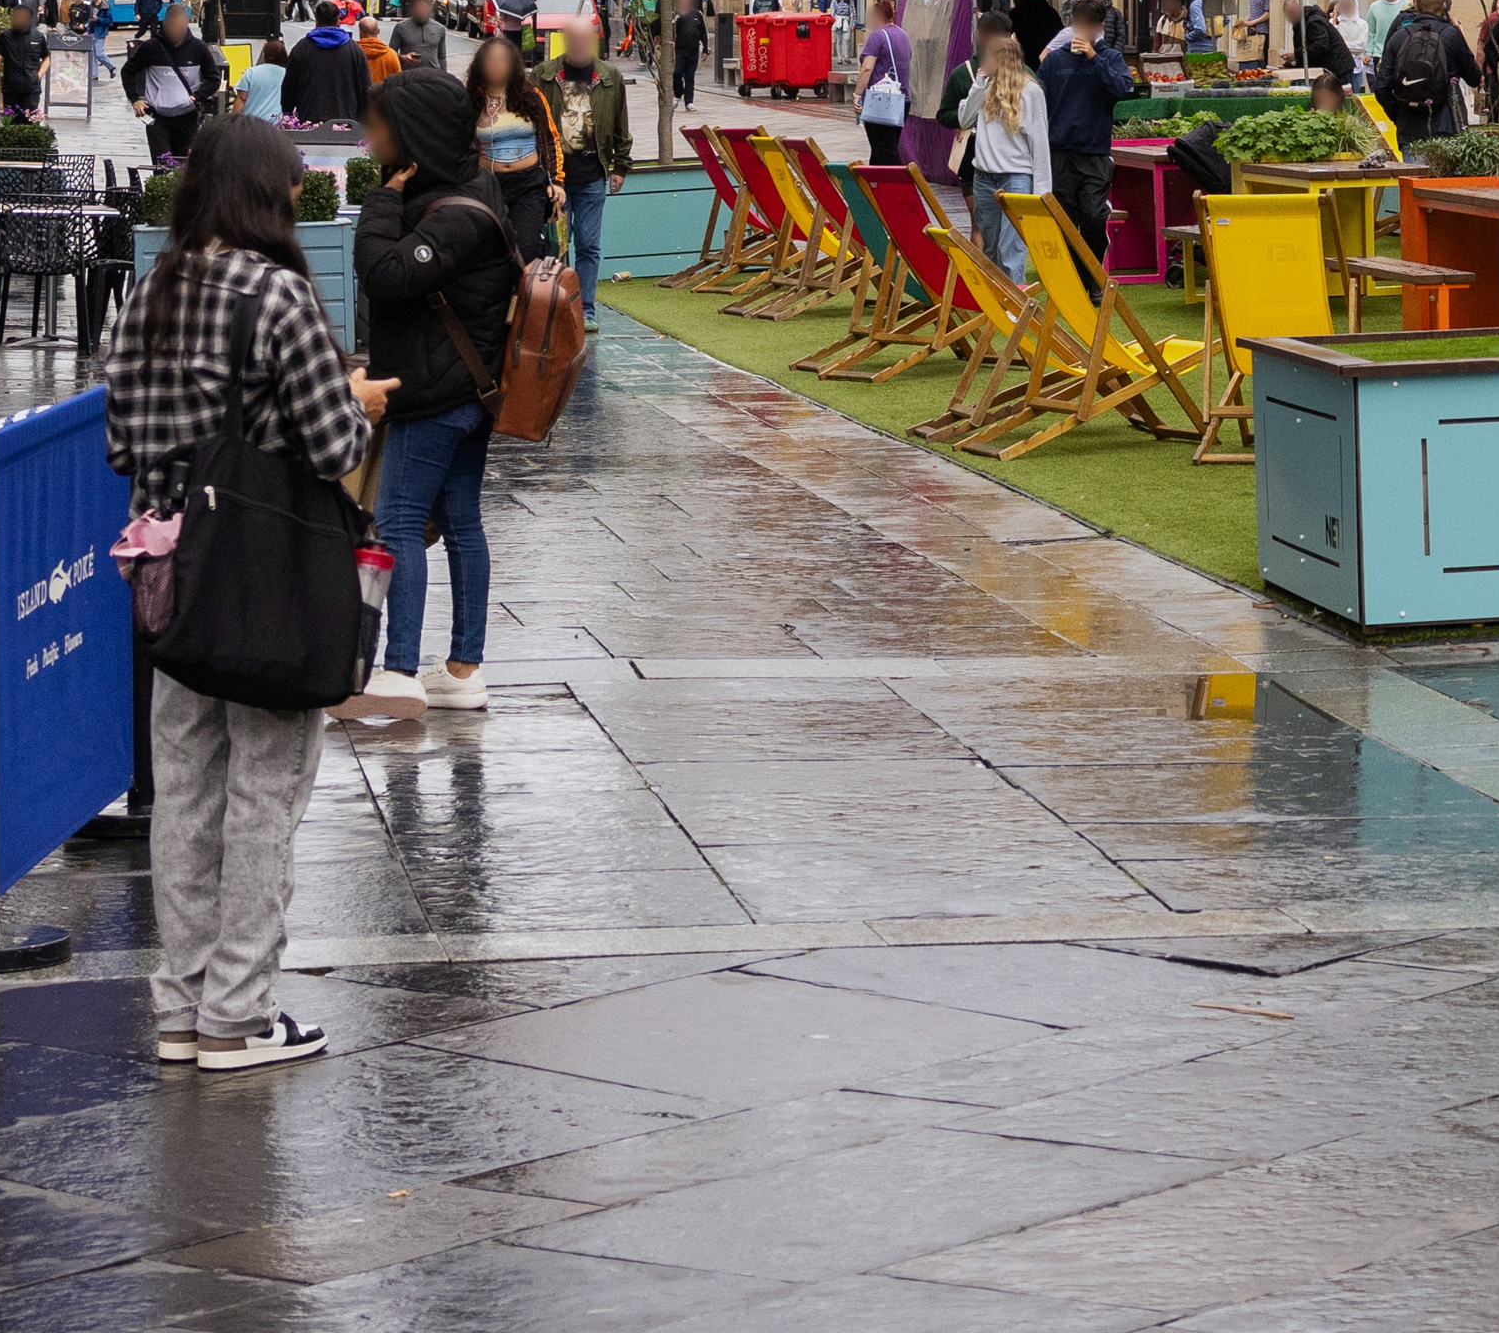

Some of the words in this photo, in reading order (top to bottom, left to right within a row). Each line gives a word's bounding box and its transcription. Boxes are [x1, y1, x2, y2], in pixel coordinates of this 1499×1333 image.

[1324, 514, 1341, 549] NE1
[17, 579, 48, 621] ISLAND
[73, 544, 95, 587] POKÉ
